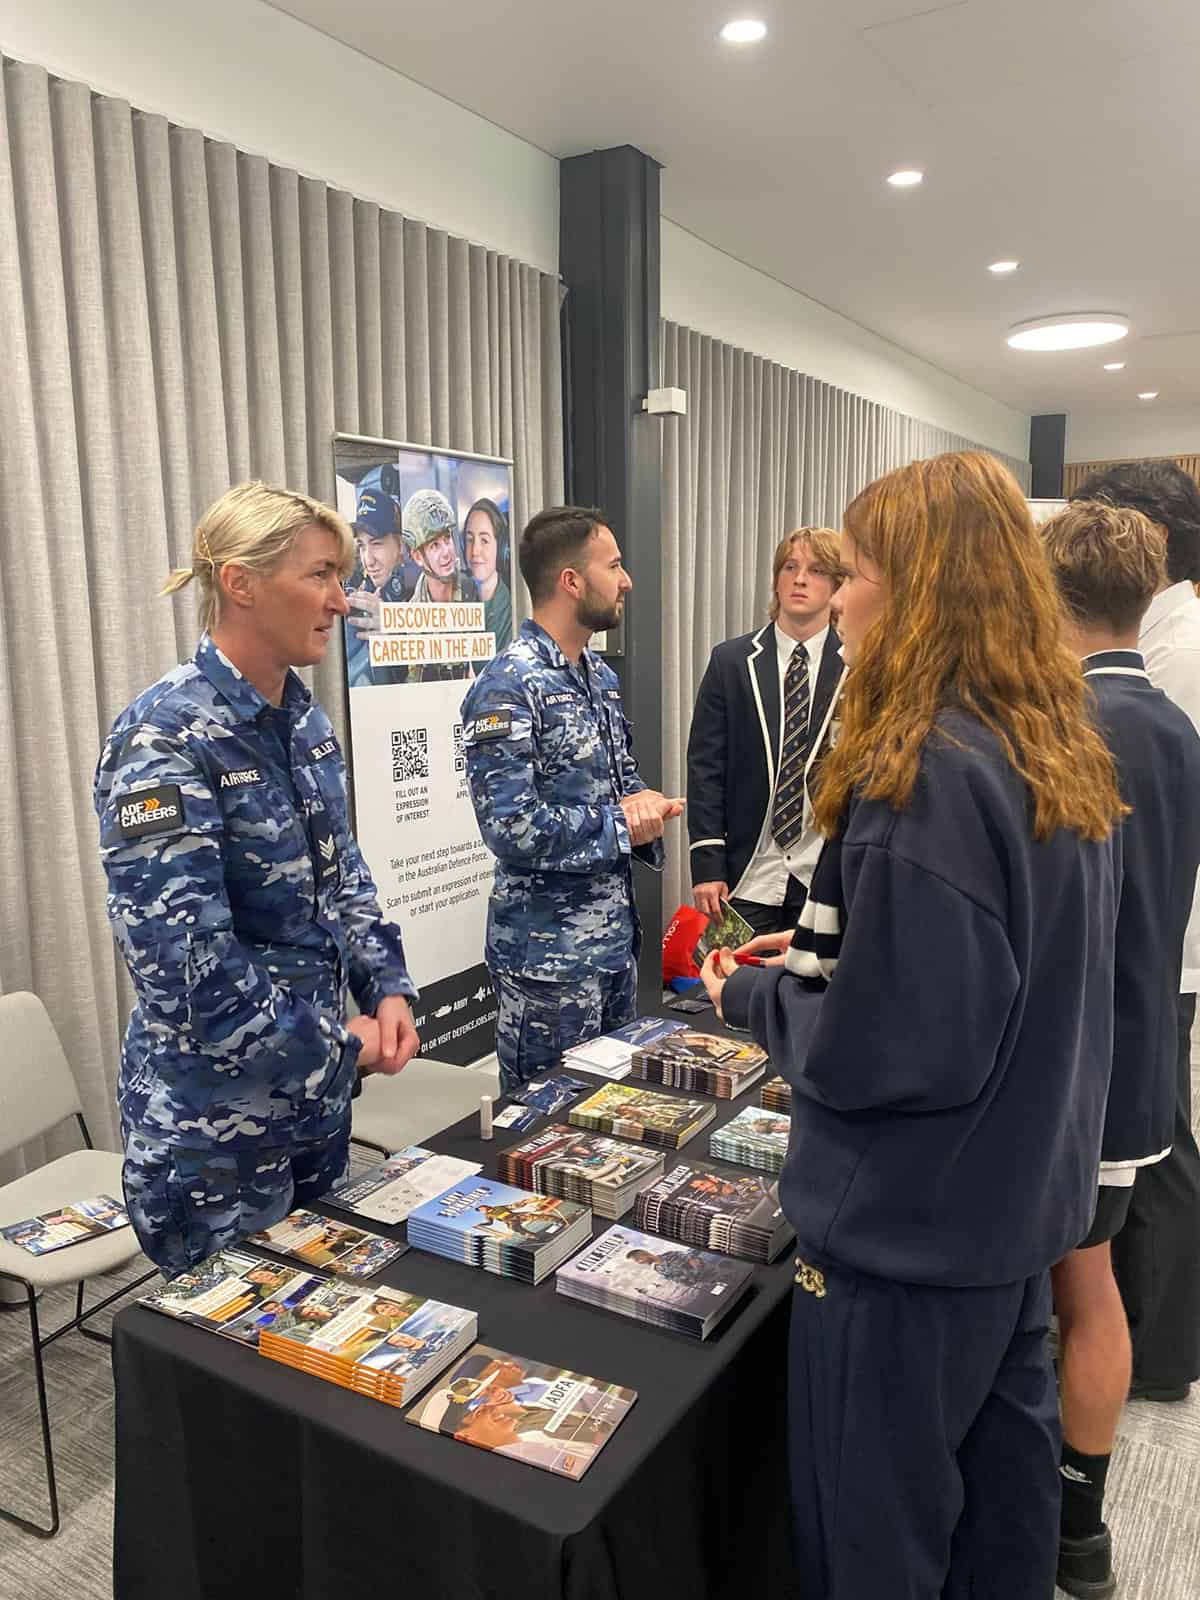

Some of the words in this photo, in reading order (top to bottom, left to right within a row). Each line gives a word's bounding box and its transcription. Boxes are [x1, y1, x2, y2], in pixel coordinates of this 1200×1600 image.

[383, 607, 447, 628] DISCOVER
[450, 607, 482, 626] YOUR
[372, 639, 426, 662] CAREER
[429, 639, 442, 659] IN
[445, 638, 469, 658] THE
[471, 637, 494, 657] ADF
[407, 786, 419, 797] OUT
[420, 785, 428, 794] AN
[456, 789, 470, 799] APPL
[121, 801, 145, 818] ADF
[395, 798, 429, 812] EXPRESSION
[121, 805, 178, 828] CAREERS
[395, 814, 403, 824] OF
[404, 808, 430, 822] INTEREST
[390, 858, 405, 870] Take
[405, 855, 420, 868] your
[420, 848, 436, 862] next
[436, 846, 450, 860] step
[450, 840, 473, 855] towards
[398, 873, 405, 883] in
[405, 869, 417, 882] the
[417, 862, 448, 878] Australian
[448, 856, 472, 870] Defence
[386, 896, 402, 910] Scan
[402, 892, 410, 904] to
[410, 885, 432, 902] submit
[433, 885, 441, 895] an
[441, 876, 472, 895] expression
[472, 871, 478, 883] of
[409, 907, 417, 917] or
[418, 901, 435, 914] start
[435, 897, 449, 912] your
[437, 1031, 452, 1046] VISIT
[544, 1379, 575, 1406] ADFA
